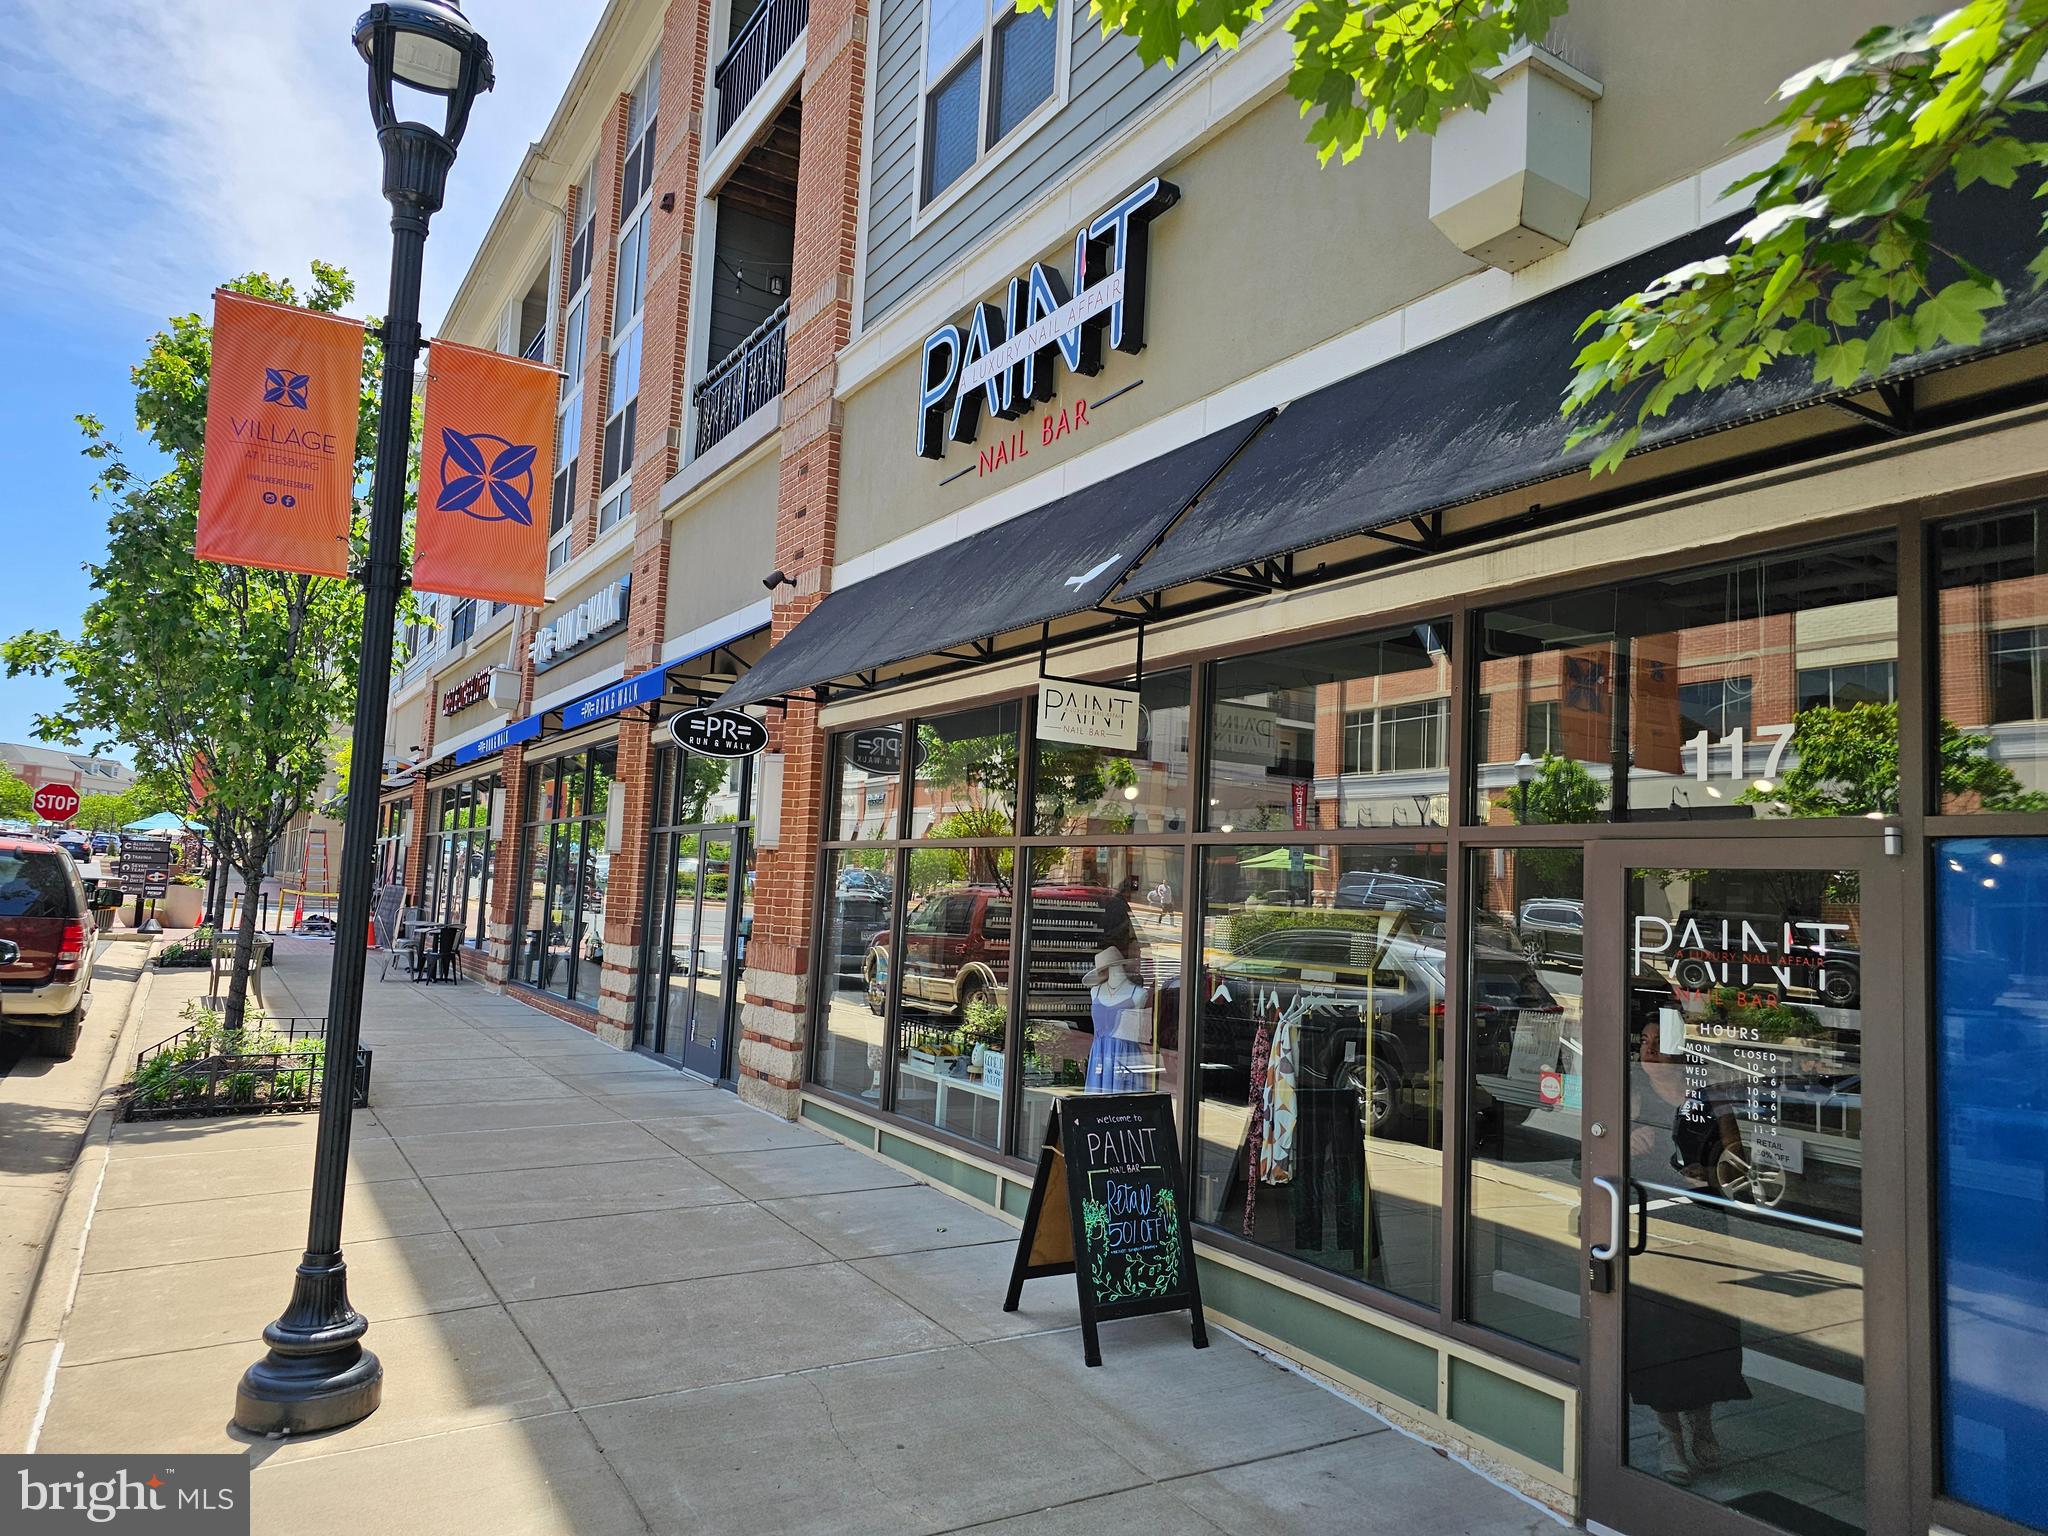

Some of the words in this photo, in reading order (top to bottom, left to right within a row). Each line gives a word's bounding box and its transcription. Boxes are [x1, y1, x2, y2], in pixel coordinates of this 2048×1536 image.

[915, 176, 1181, 459] PAINT
[959, 377, 966, 392] A
[972, 343, 1021, 383] LUXURY
[1028, 316, 1060, 349] NAIL
[1067, 278, 1122, 325] AFFAIR
[231, 417, 336, 454] VILLAGE
[979, 430, 1028, 477] NAIL
[1042, 400, 1089, 446] BAR
[244, 450, 259, 460] AT
[261, 452, 320, 471] LEESBURG
[617, 683, 638, 707] WALK
[1044, 688, 1133, 730] PAINT
[1063, 725, 1084, 735] NAIL
[1088, 728, 1106, 738] BAR
[689, 736, 708, 746] RUN
[714, 739, 720, 748] &
[725, 740, 751, 751] WALK
[1686, 723, 1795, 782] 117
[36, 794, 77, 811] STOP
[1635, 915, 1850, 992] PAINT
[1689, 951, 1736, 962] LUXURY
[1742, 954, 1772, 964] NAIL
[1778, 956, 1825, 968] AFFAIR
[1675, 987, 1723, 1006] NAIL
[1737, 993, 1779, 1009] BAR
[1700, 1023, 1759, 1041] HOURS
[1686, 1043, 1710, 1053] MON
[1733, 1049, 1777, 1062] CLOSED
[1686, 1055, 1705, 1064] TUE
[1686, 1066, 1708, 1076] WED
[1686, 1078, 1706, 1088] THU
[1686, 1090, 1701, 1099] FRI
[1686, 1102, 1704, 1111] SAT
[1096, 1114, 1132, 1124] welcome
[1133, 1114, 1143, 1122] to
[1087, 1127, 1157, 1165] PAINT
[1756, 1138, 1784, 1151] RETAIL
[1110, 1165, 1126, 1175] NAIL
[1126, 1163, 1141, 1173] BAR
[1106, 1179, 1157, 1221] Retail
